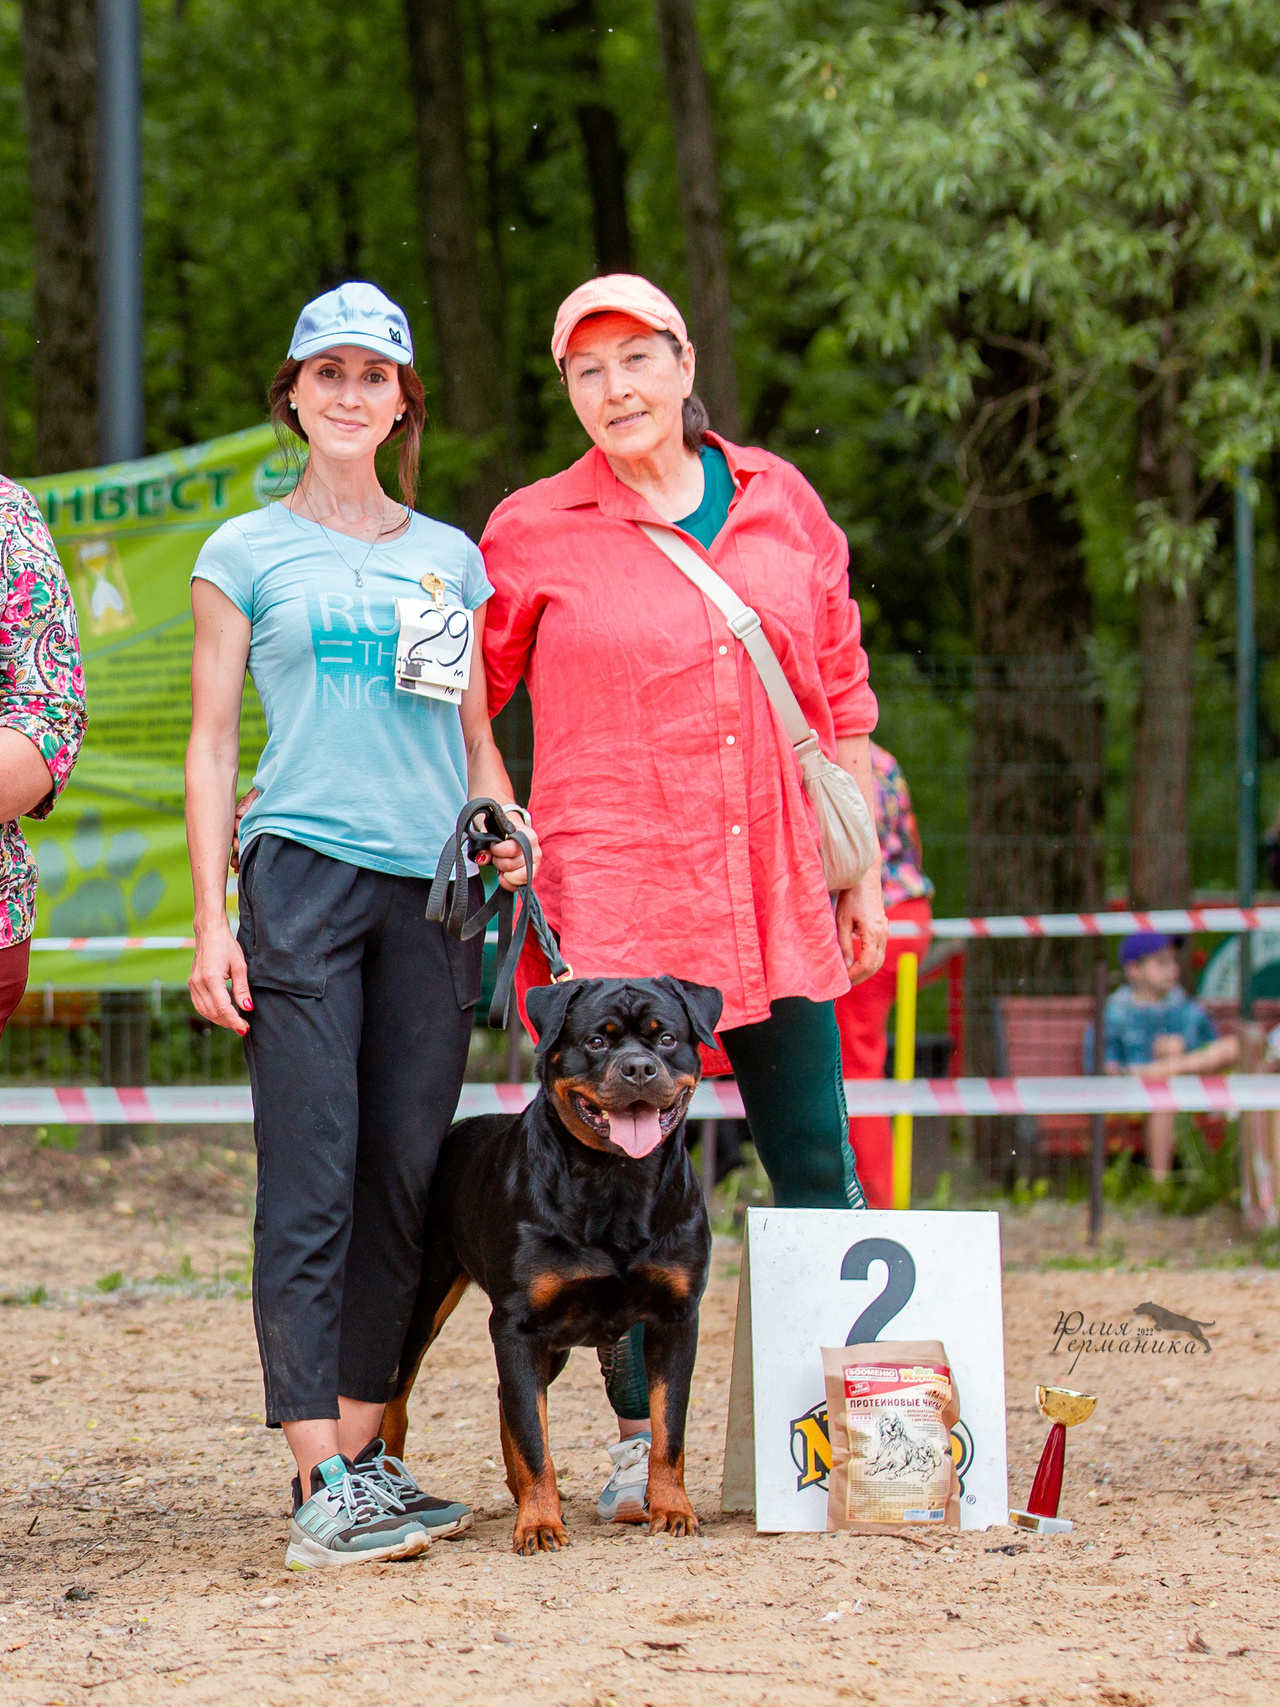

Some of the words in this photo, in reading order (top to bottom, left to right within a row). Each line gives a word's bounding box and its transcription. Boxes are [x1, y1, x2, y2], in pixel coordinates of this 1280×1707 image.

[38, 466, 236, 526] НВЕСТ
[408, 609, 469, 667] 29
[840, 1237, 916, 1346] 2
